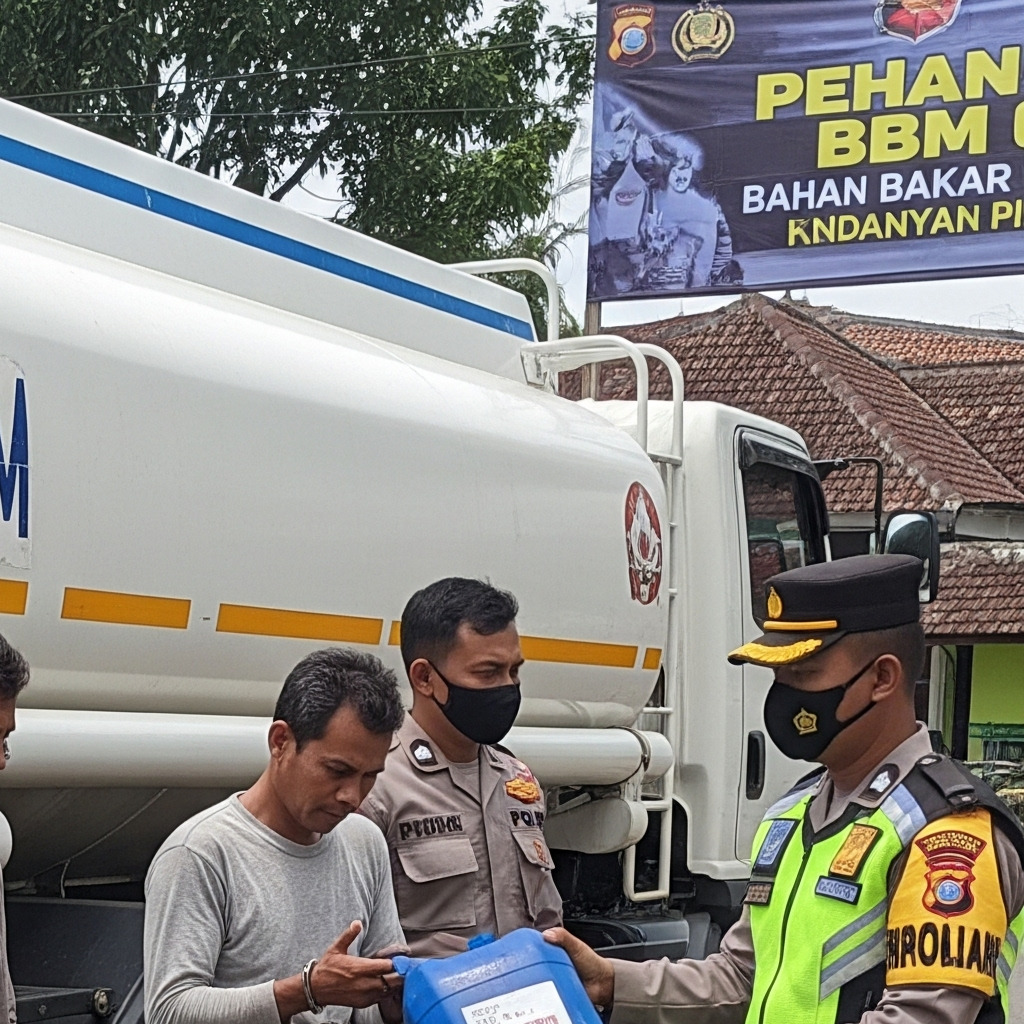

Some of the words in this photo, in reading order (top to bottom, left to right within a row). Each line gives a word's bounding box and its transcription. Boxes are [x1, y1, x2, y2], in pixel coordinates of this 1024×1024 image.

[756, 46, 1020, 120] PEHAN
[817, 105, 989, 169] BBM
[742, 176, 867, 214] BAHAN
[879, 163, 1012, 204] BAKAR
